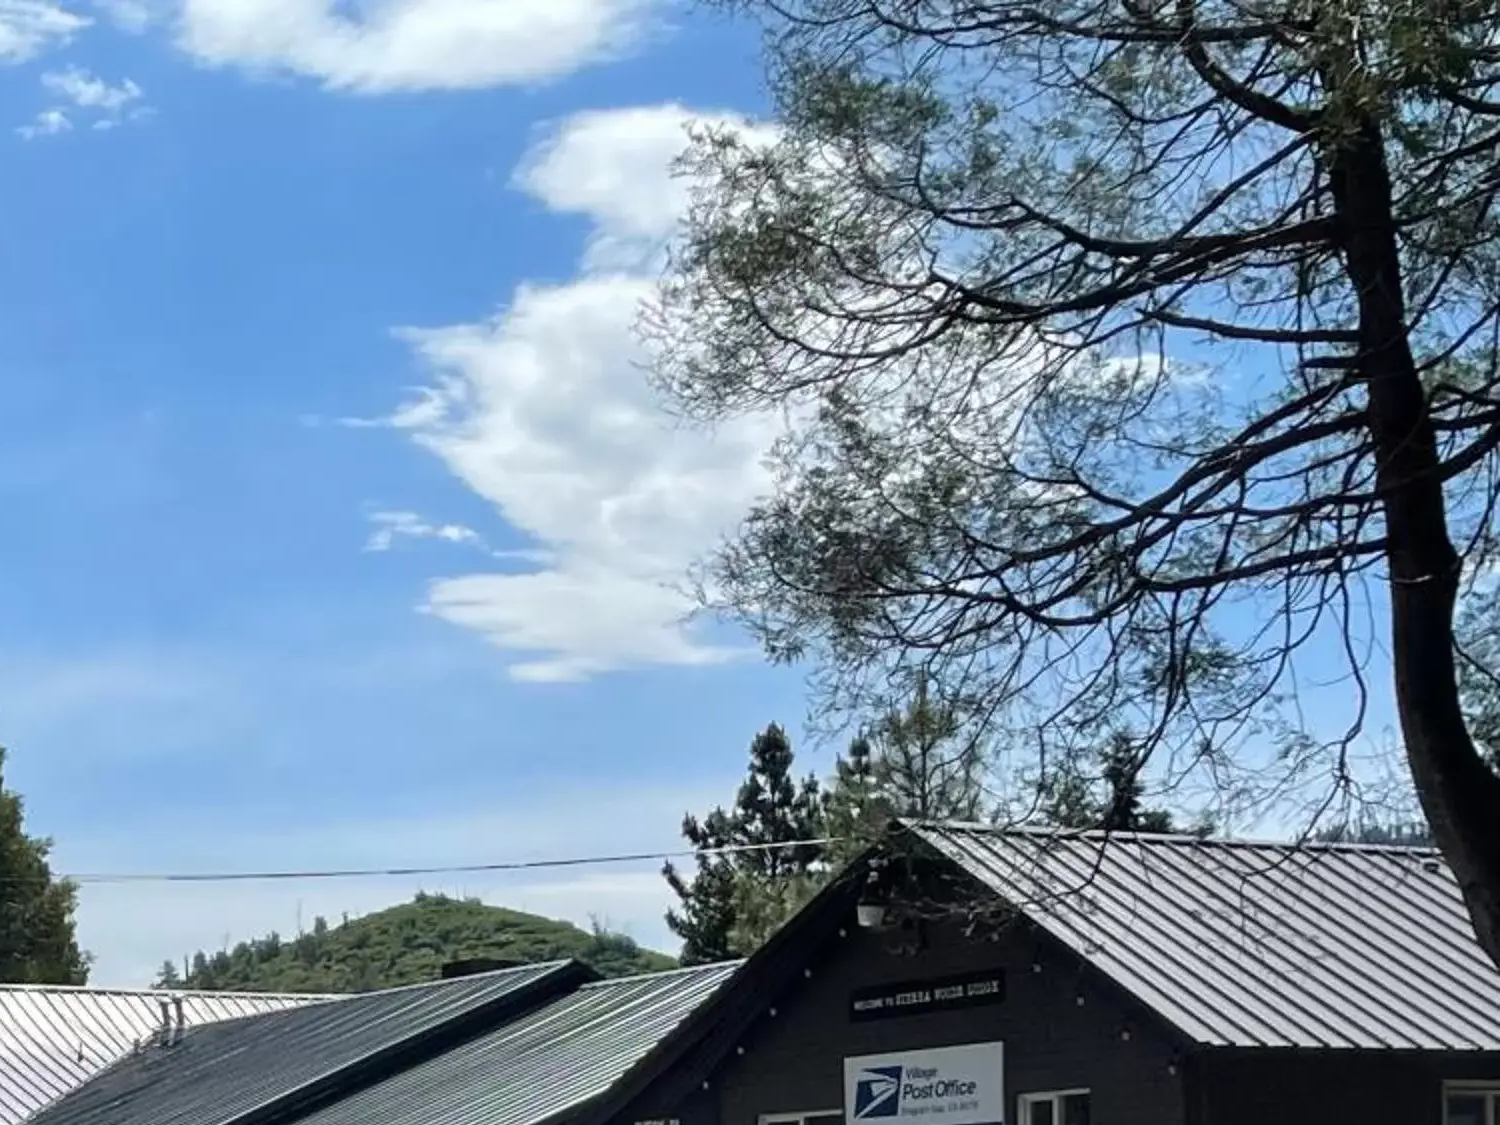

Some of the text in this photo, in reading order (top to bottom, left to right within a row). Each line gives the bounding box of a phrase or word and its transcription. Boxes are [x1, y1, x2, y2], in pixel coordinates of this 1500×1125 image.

[906, 1067, 938, 1081] Village
[903, 1080, 977, 1100] Post Office
